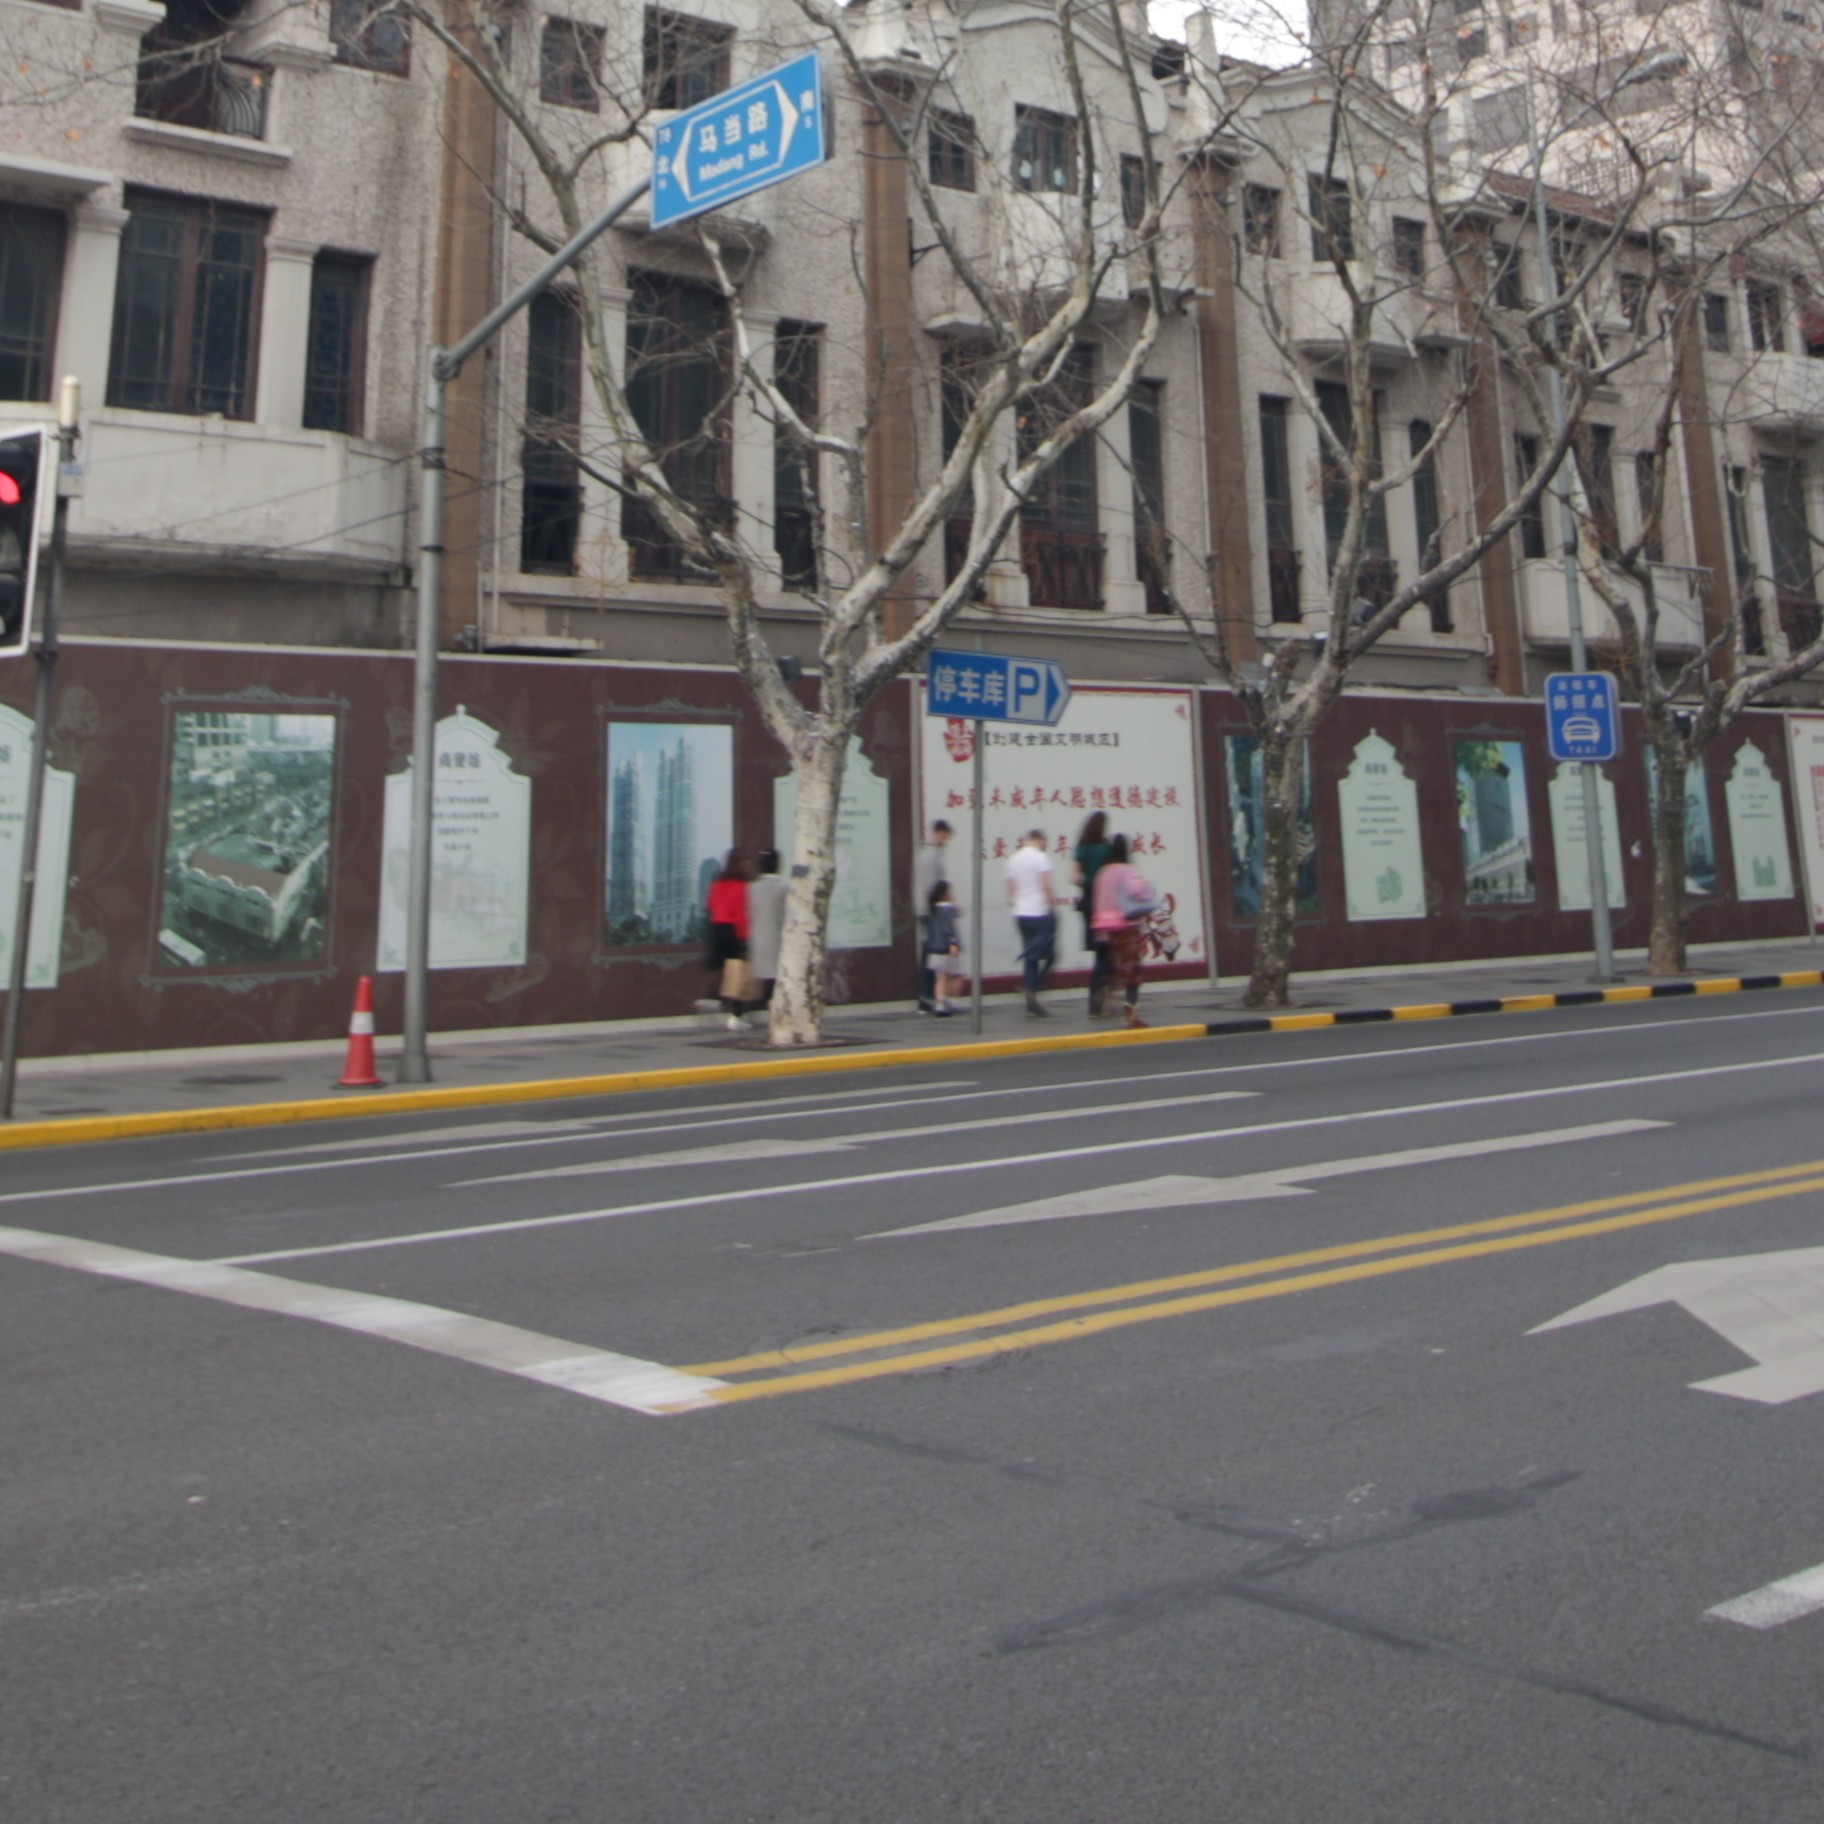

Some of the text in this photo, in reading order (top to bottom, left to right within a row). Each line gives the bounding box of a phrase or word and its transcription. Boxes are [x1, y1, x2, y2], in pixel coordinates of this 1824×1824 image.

[699, 101, 768, 153] 马当路
[699, 153, 745, 182] Madang
[933, 664, 1006, 706] 停车库
